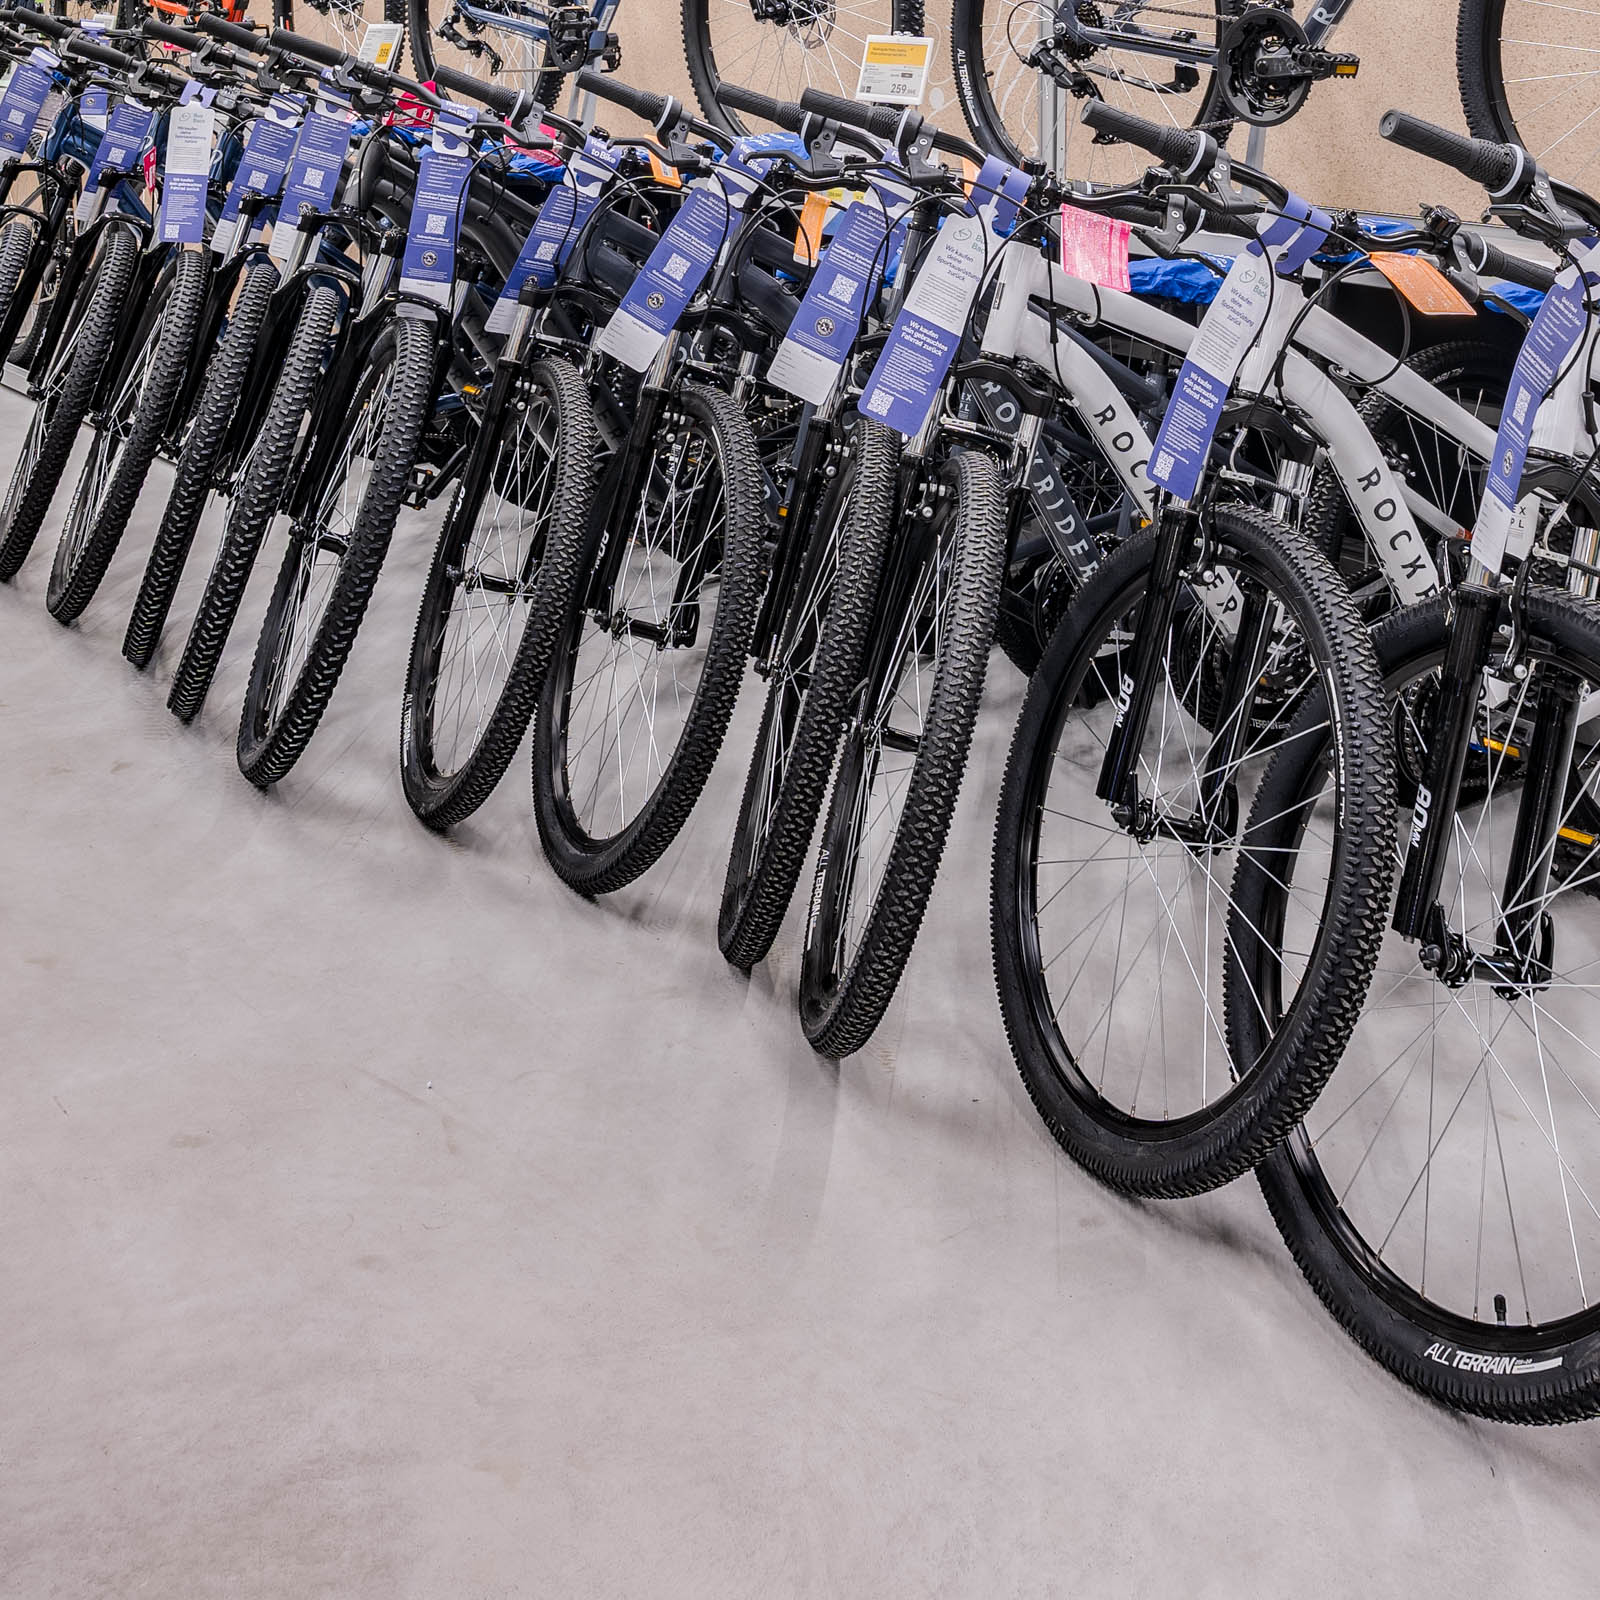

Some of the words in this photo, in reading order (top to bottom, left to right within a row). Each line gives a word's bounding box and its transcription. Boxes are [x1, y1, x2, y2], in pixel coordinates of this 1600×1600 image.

[957, 48, 967, 65] ALL
[959, 64, 974, 100] TERRAIN
[600, 152, 617, 164] Bike
[746, 159, 763, 174] Bike
[901, 325, 914, 336] dein
[909, 320, 920, 330] Wir
[919, 323, 939, 339] kaufen
[901, 332, 922, 348] Fahrrad
[922, 342, 943, 357] zurück
[818, 848, 830, 870] ALL
[811, 868, 826, 918] TERRAIN
[1424, 1342, 1452, 1365] ALL
[1452, 1350, 1517, 1375] TERRAIN
